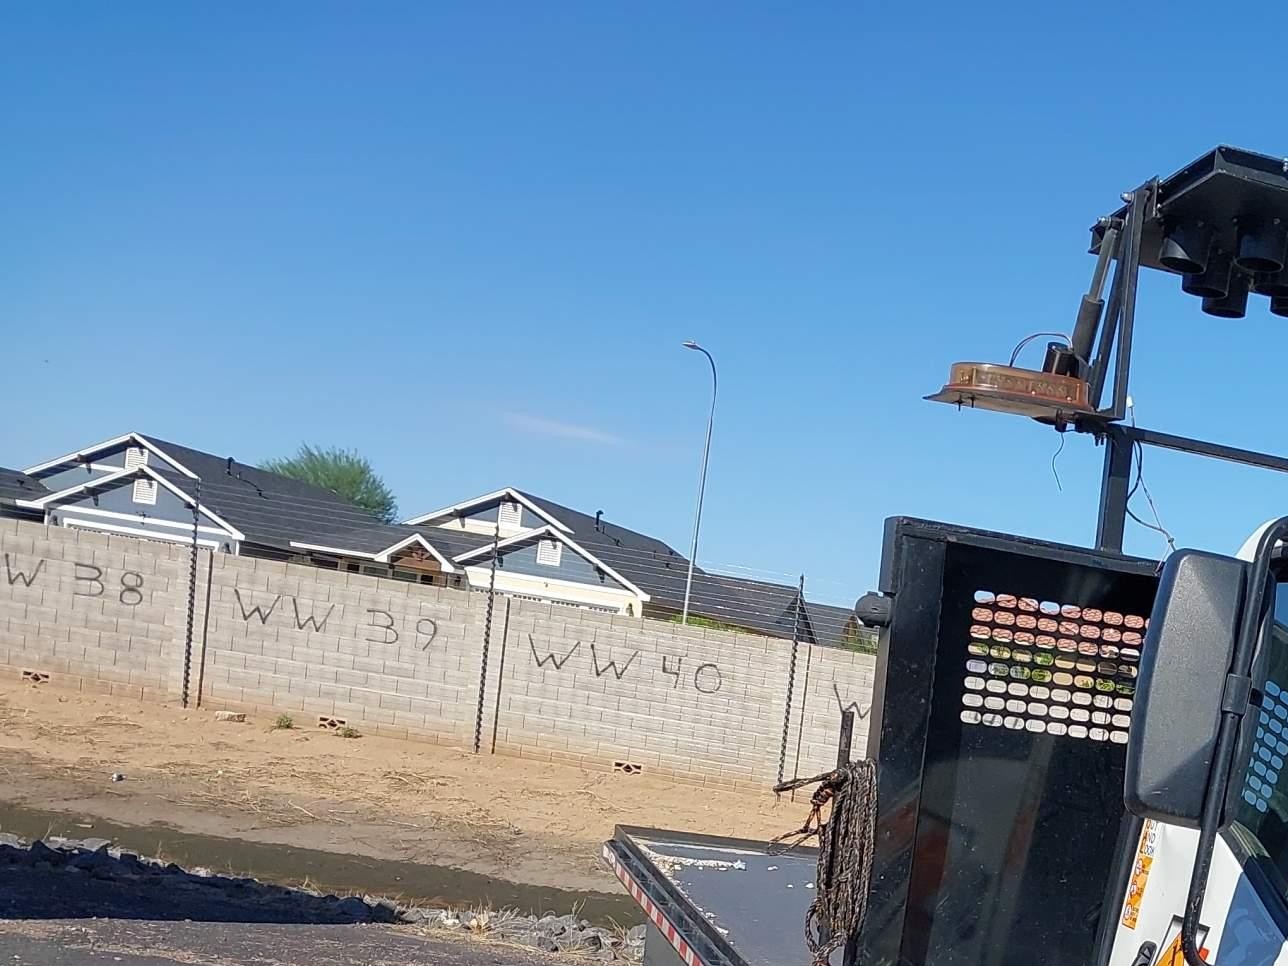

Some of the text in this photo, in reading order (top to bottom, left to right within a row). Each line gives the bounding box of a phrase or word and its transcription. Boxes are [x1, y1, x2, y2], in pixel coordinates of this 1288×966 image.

[73, 562, 144, 606] 38
[234, 588, 438, 651] WW 39
[528, 633, 723, 694] WW 40
